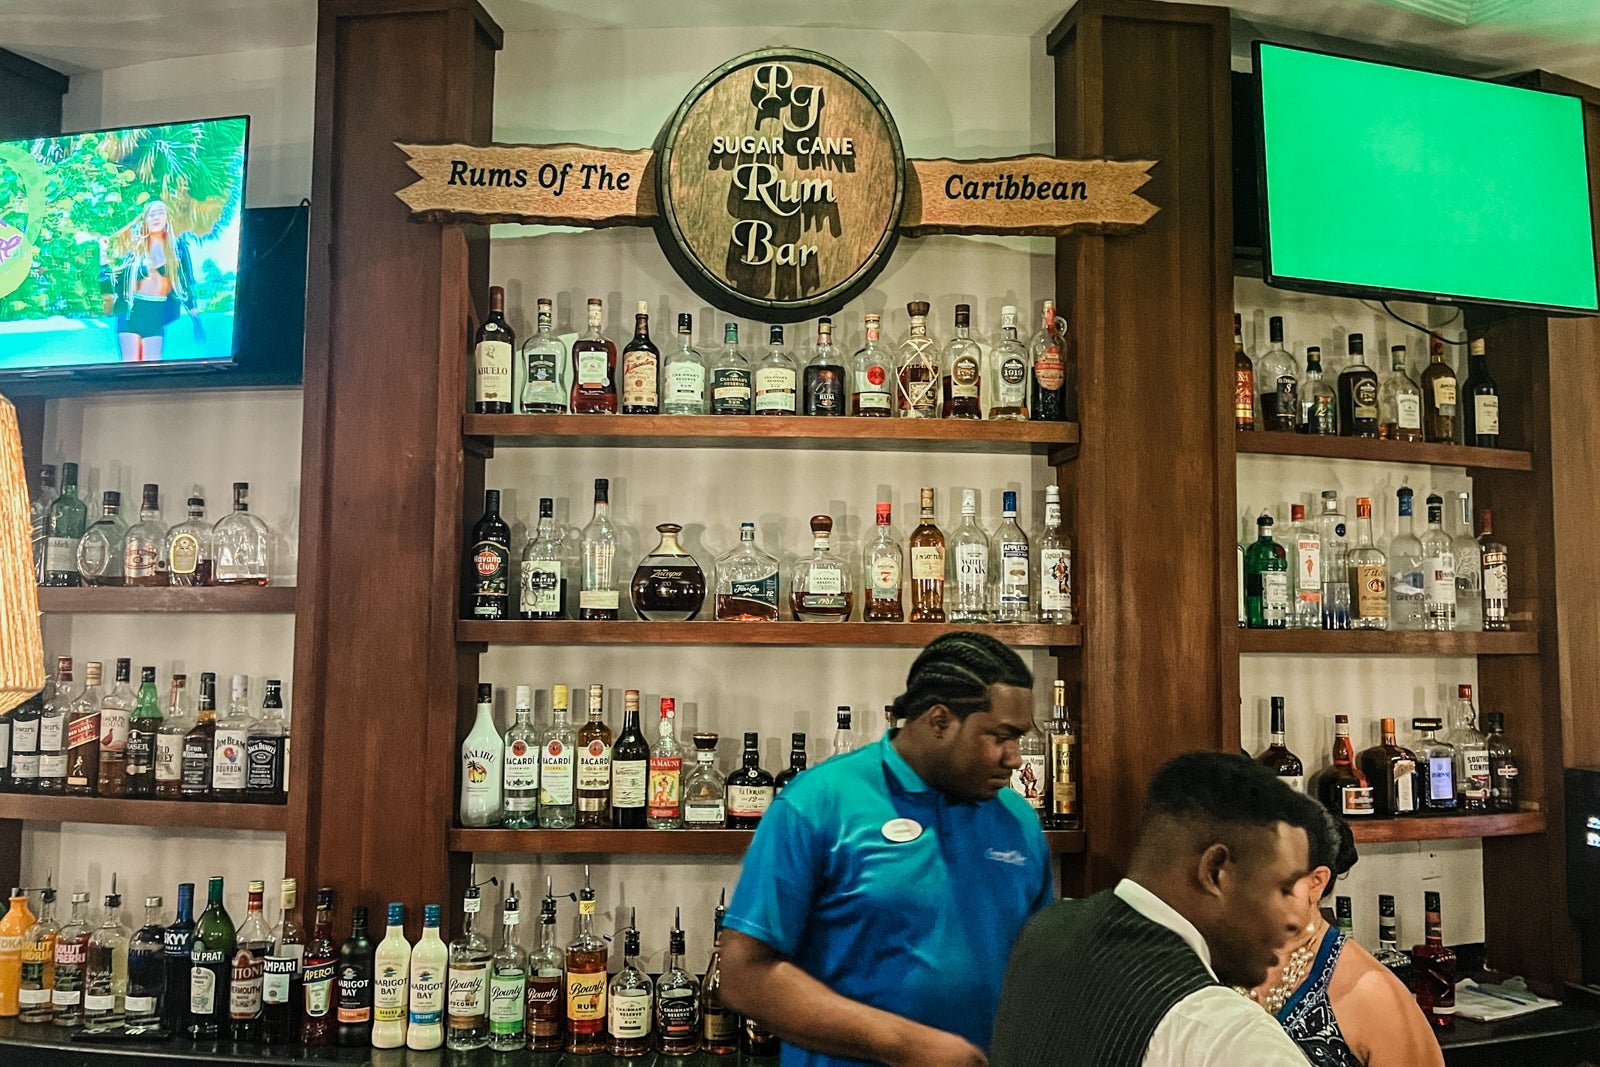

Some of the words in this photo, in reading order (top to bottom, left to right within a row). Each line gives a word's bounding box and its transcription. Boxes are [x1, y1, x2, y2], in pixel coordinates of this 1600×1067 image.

[713, 136, 784, 154] SUGAR
[796, 137, 853, 155] CANE
[448, 161, 527, 187] Rums
[538, 163, 573, 196] Of
[580, 164, 630, 191] The
[732, 162, 837, 217] Rum
[945, 174, 1088, 200] Caribbean
[731, 219, 818, 266] Bar
[473, 555, 502, 563] Havana
[477, 562, 495, 570] Club
[880, 571, 891, 582] 7
[482, 580, 490, 589] 7
[78, 723, 93, 733] LABEL
[185, 744, 202, 752] Evan
[215, 739, 227, 750] JIM
[227, 736, 246, 750] BEAM
[247, 744, 259, 754] JACK
[463, 750, 496, 763] MALIBU
[216, 765, 242, 773] BOURBON
[164, 931, 189, 945] SKYY
[201, 951, 222, 961] PRAT
[303, 966, 335, 982] APEROL
[341, 989, 357, 997] BAY
[449, 978, 483, 995] Bounty
[491, 985, 523, 1000] Bounty
[570, 980, 605, 998] Bounty
[527, 988, 558, 1003] Bounty
